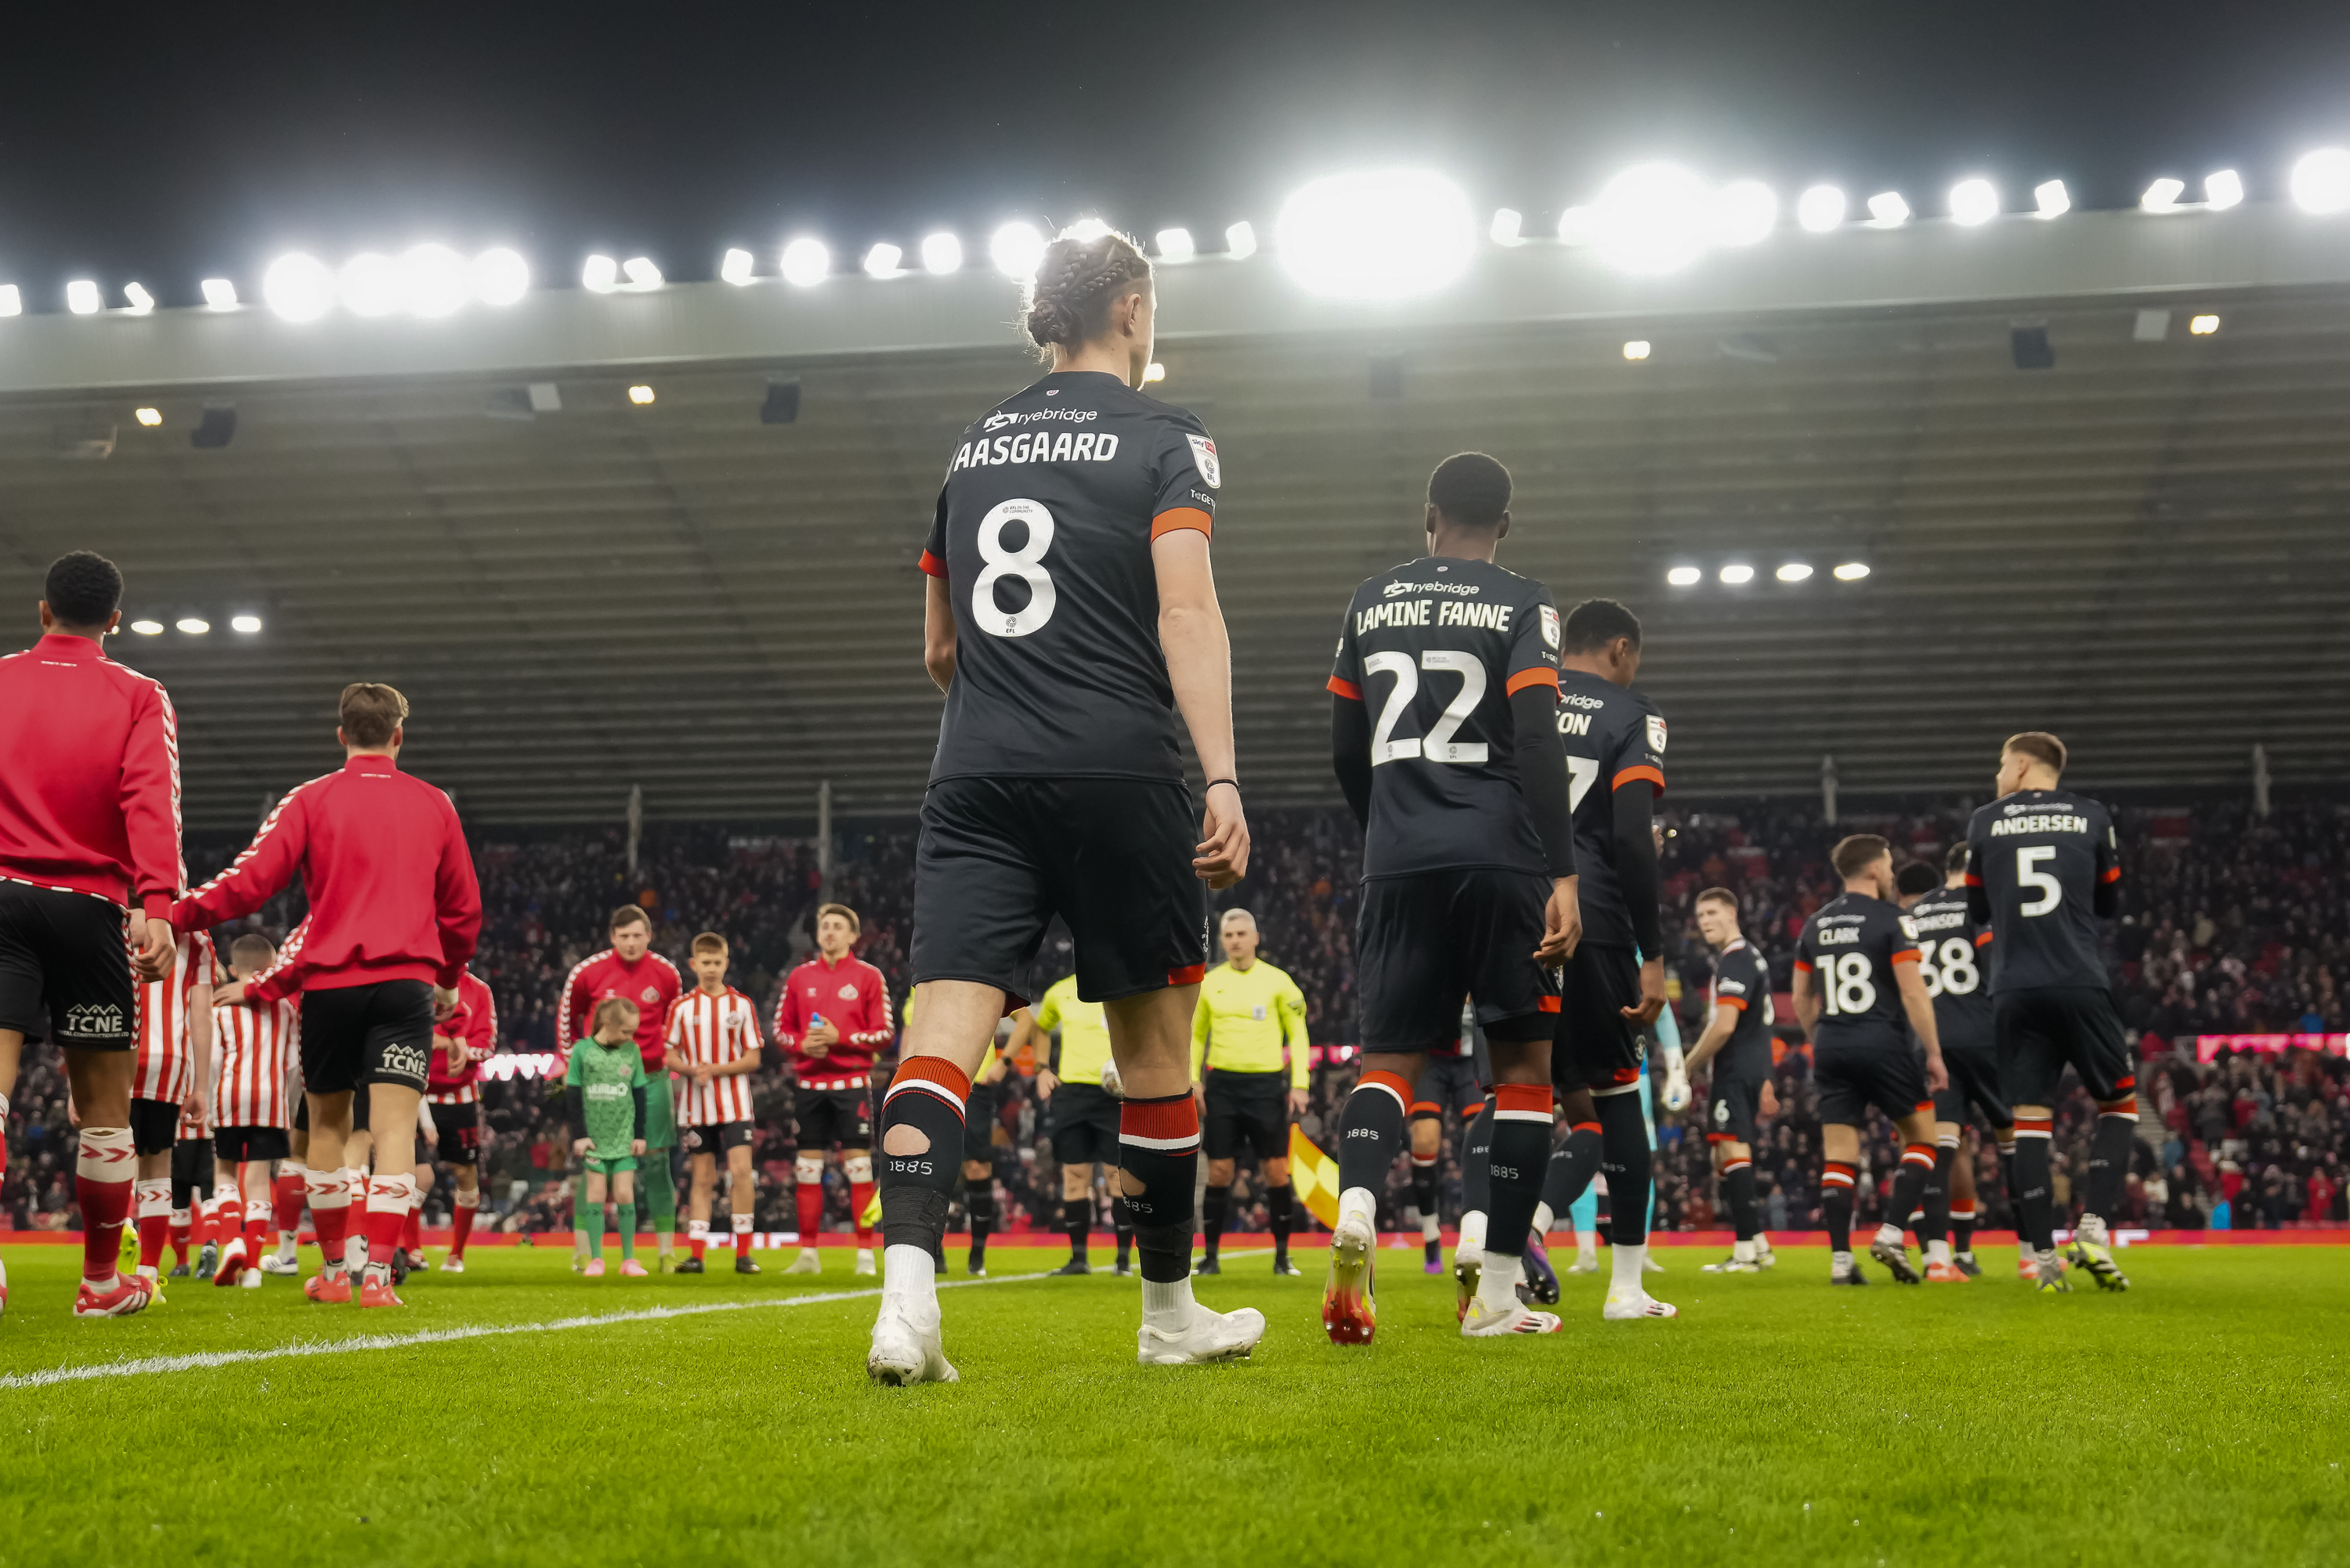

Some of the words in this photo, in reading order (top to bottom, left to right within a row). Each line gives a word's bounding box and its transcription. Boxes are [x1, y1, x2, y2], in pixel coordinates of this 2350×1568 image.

[1018, 407, 1097, 425] ryebridge
[953, 432, 1119, 472] AASGAARD
[972, 497, 1056, 637] 8
[1412, 581, 1480, 596] ryebridge
[1357, 599, 1433, 637] LAMINE
[1437, 601, 1513, 632] FANNE
[1364, 650, 1488, 767] 22
[1990, 815, 2088, 836] ANDERSEN
[2016, 845, 2063, 917] 5
[1818, 927, 1860, 945] CLARK
[1815, 952, 1877, 1016] 18
[66, 1013, 123, 1032] TCNE
[381, 1053, 427, 1077] TCNE
[1714, 1099, 1730, 1123] 6
[1347, 1128, 1379, 1140] 1885
[889, 1160, 933, 1175] 1885
[1490, 1164, 1519, 1179] 1885
[1123, 1195, 1152, 1213] 885
